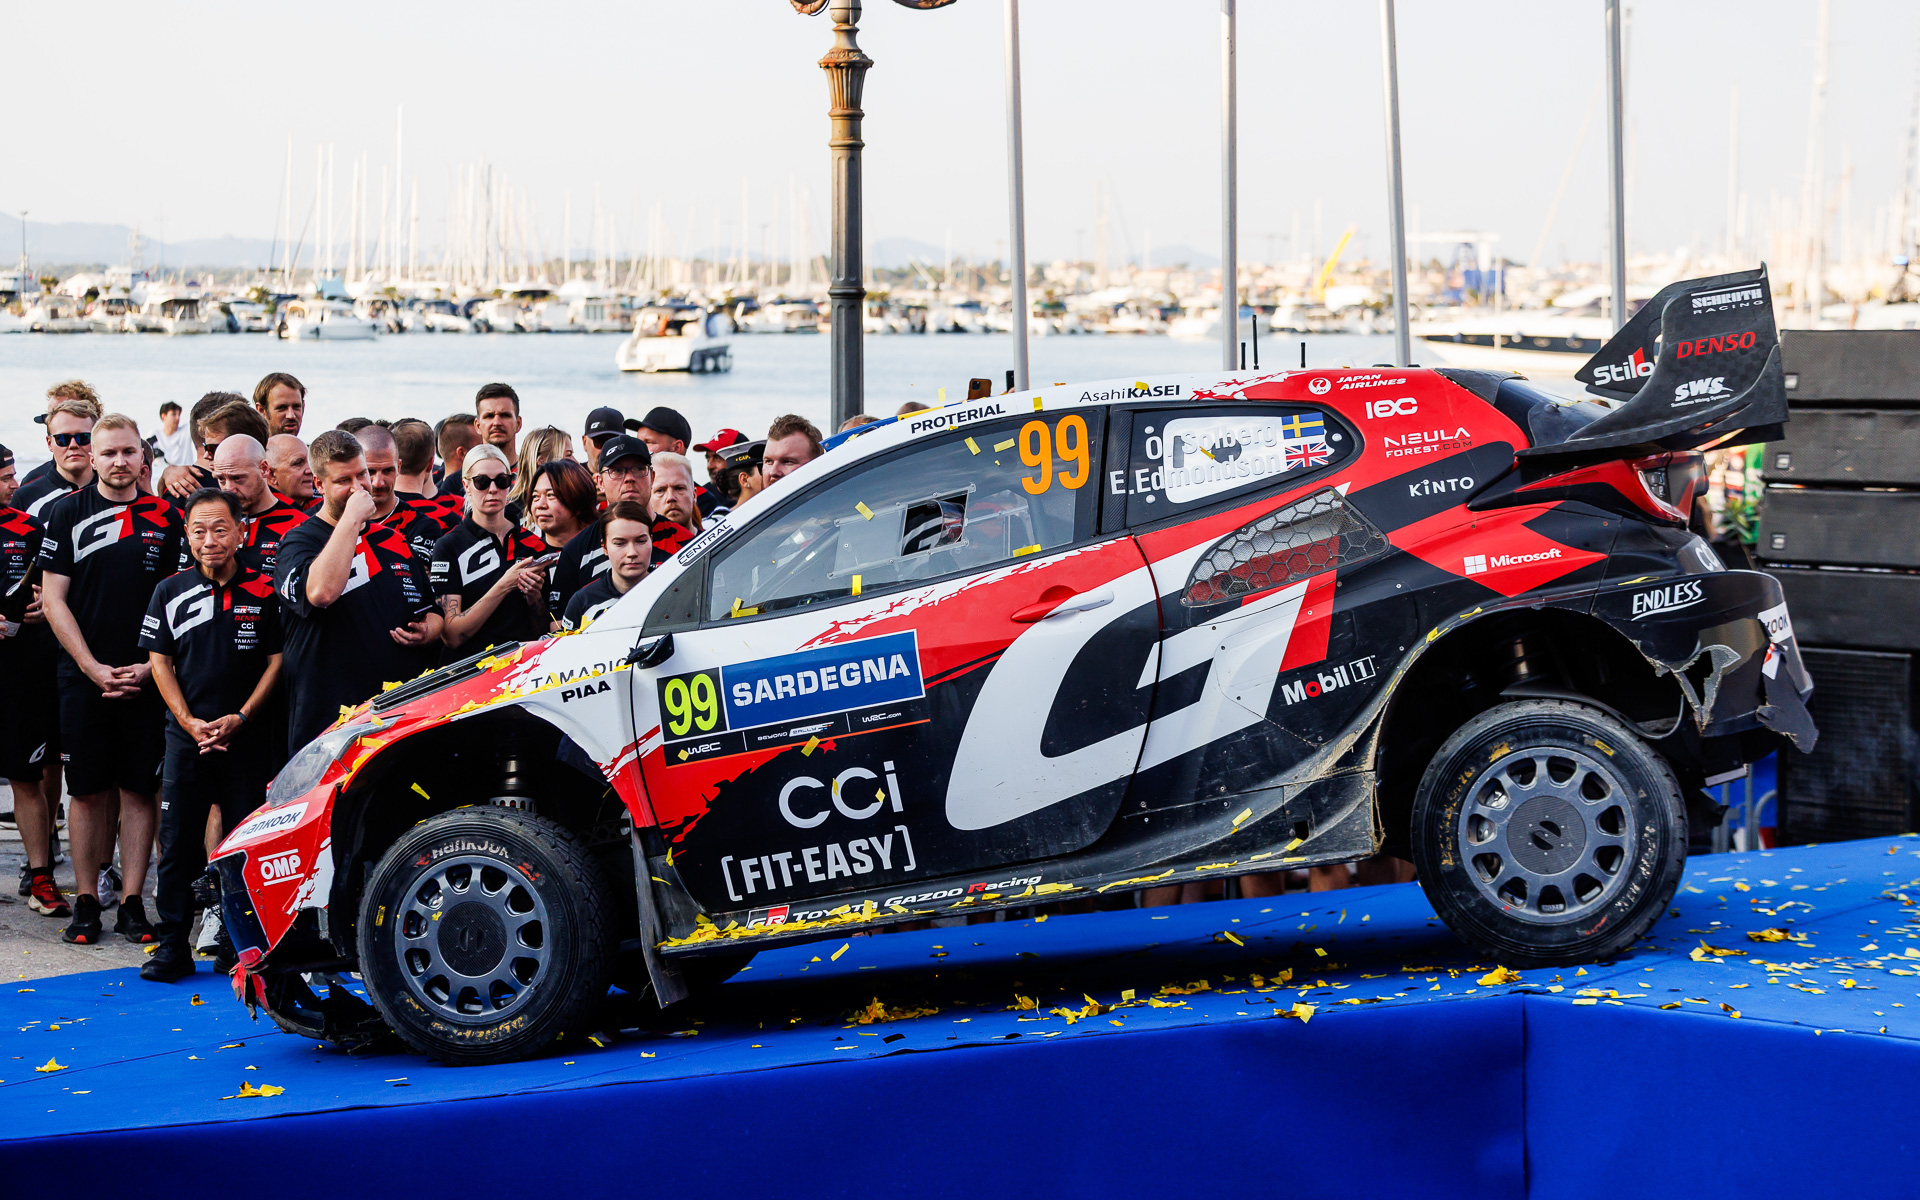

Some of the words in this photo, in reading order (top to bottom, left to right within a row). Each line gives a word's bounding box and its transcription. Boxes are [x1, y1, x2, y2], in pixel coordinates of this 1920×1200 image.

[1691, 289, 1763, 309] SCHROTH
[1693, 300, 1764, 315] RACING
[1676, 332, 1757, 359] DENSO
[1336, 374, 1381, 384] JAPAN
[1593, 347, 1657, 386] Stilo
[1080, 390, 1126, 402] Asahi
[1126, 384, 1180, 398] KASEI
[1340, 378, 1407, 390] AIRLINES
[1674, 376, 1726, 402] SWS
[910, 403, 1006, 434] PROTERIAL
[1182, 424, 1277, 454] Solberg
[1386, 440, 1472, 458] FOREST.COM
[1018, 414, 1090, 495] 99
[678, 523, 732, 565] CENTRAL
[1490, 548, 1562, 567] Microsoft
[1632, 579, 1703, 615] ENDLESS
[561, 680, 612, 703] PIAA
[732, 653, 911, 707] SARDEGNA
[1281, 665, 1350, 706] Mobil
[663, 673, 719, 736] 99
[688, 741, 721, 755] WRC
[757, 731, 788, 741] BEYOND
[778, 760, 904, 829] CCi
[260, 854, 301, 880] OMP
[884, 888, 964, 908] GAZOO
[967, 875, 1042, 894] Racing
